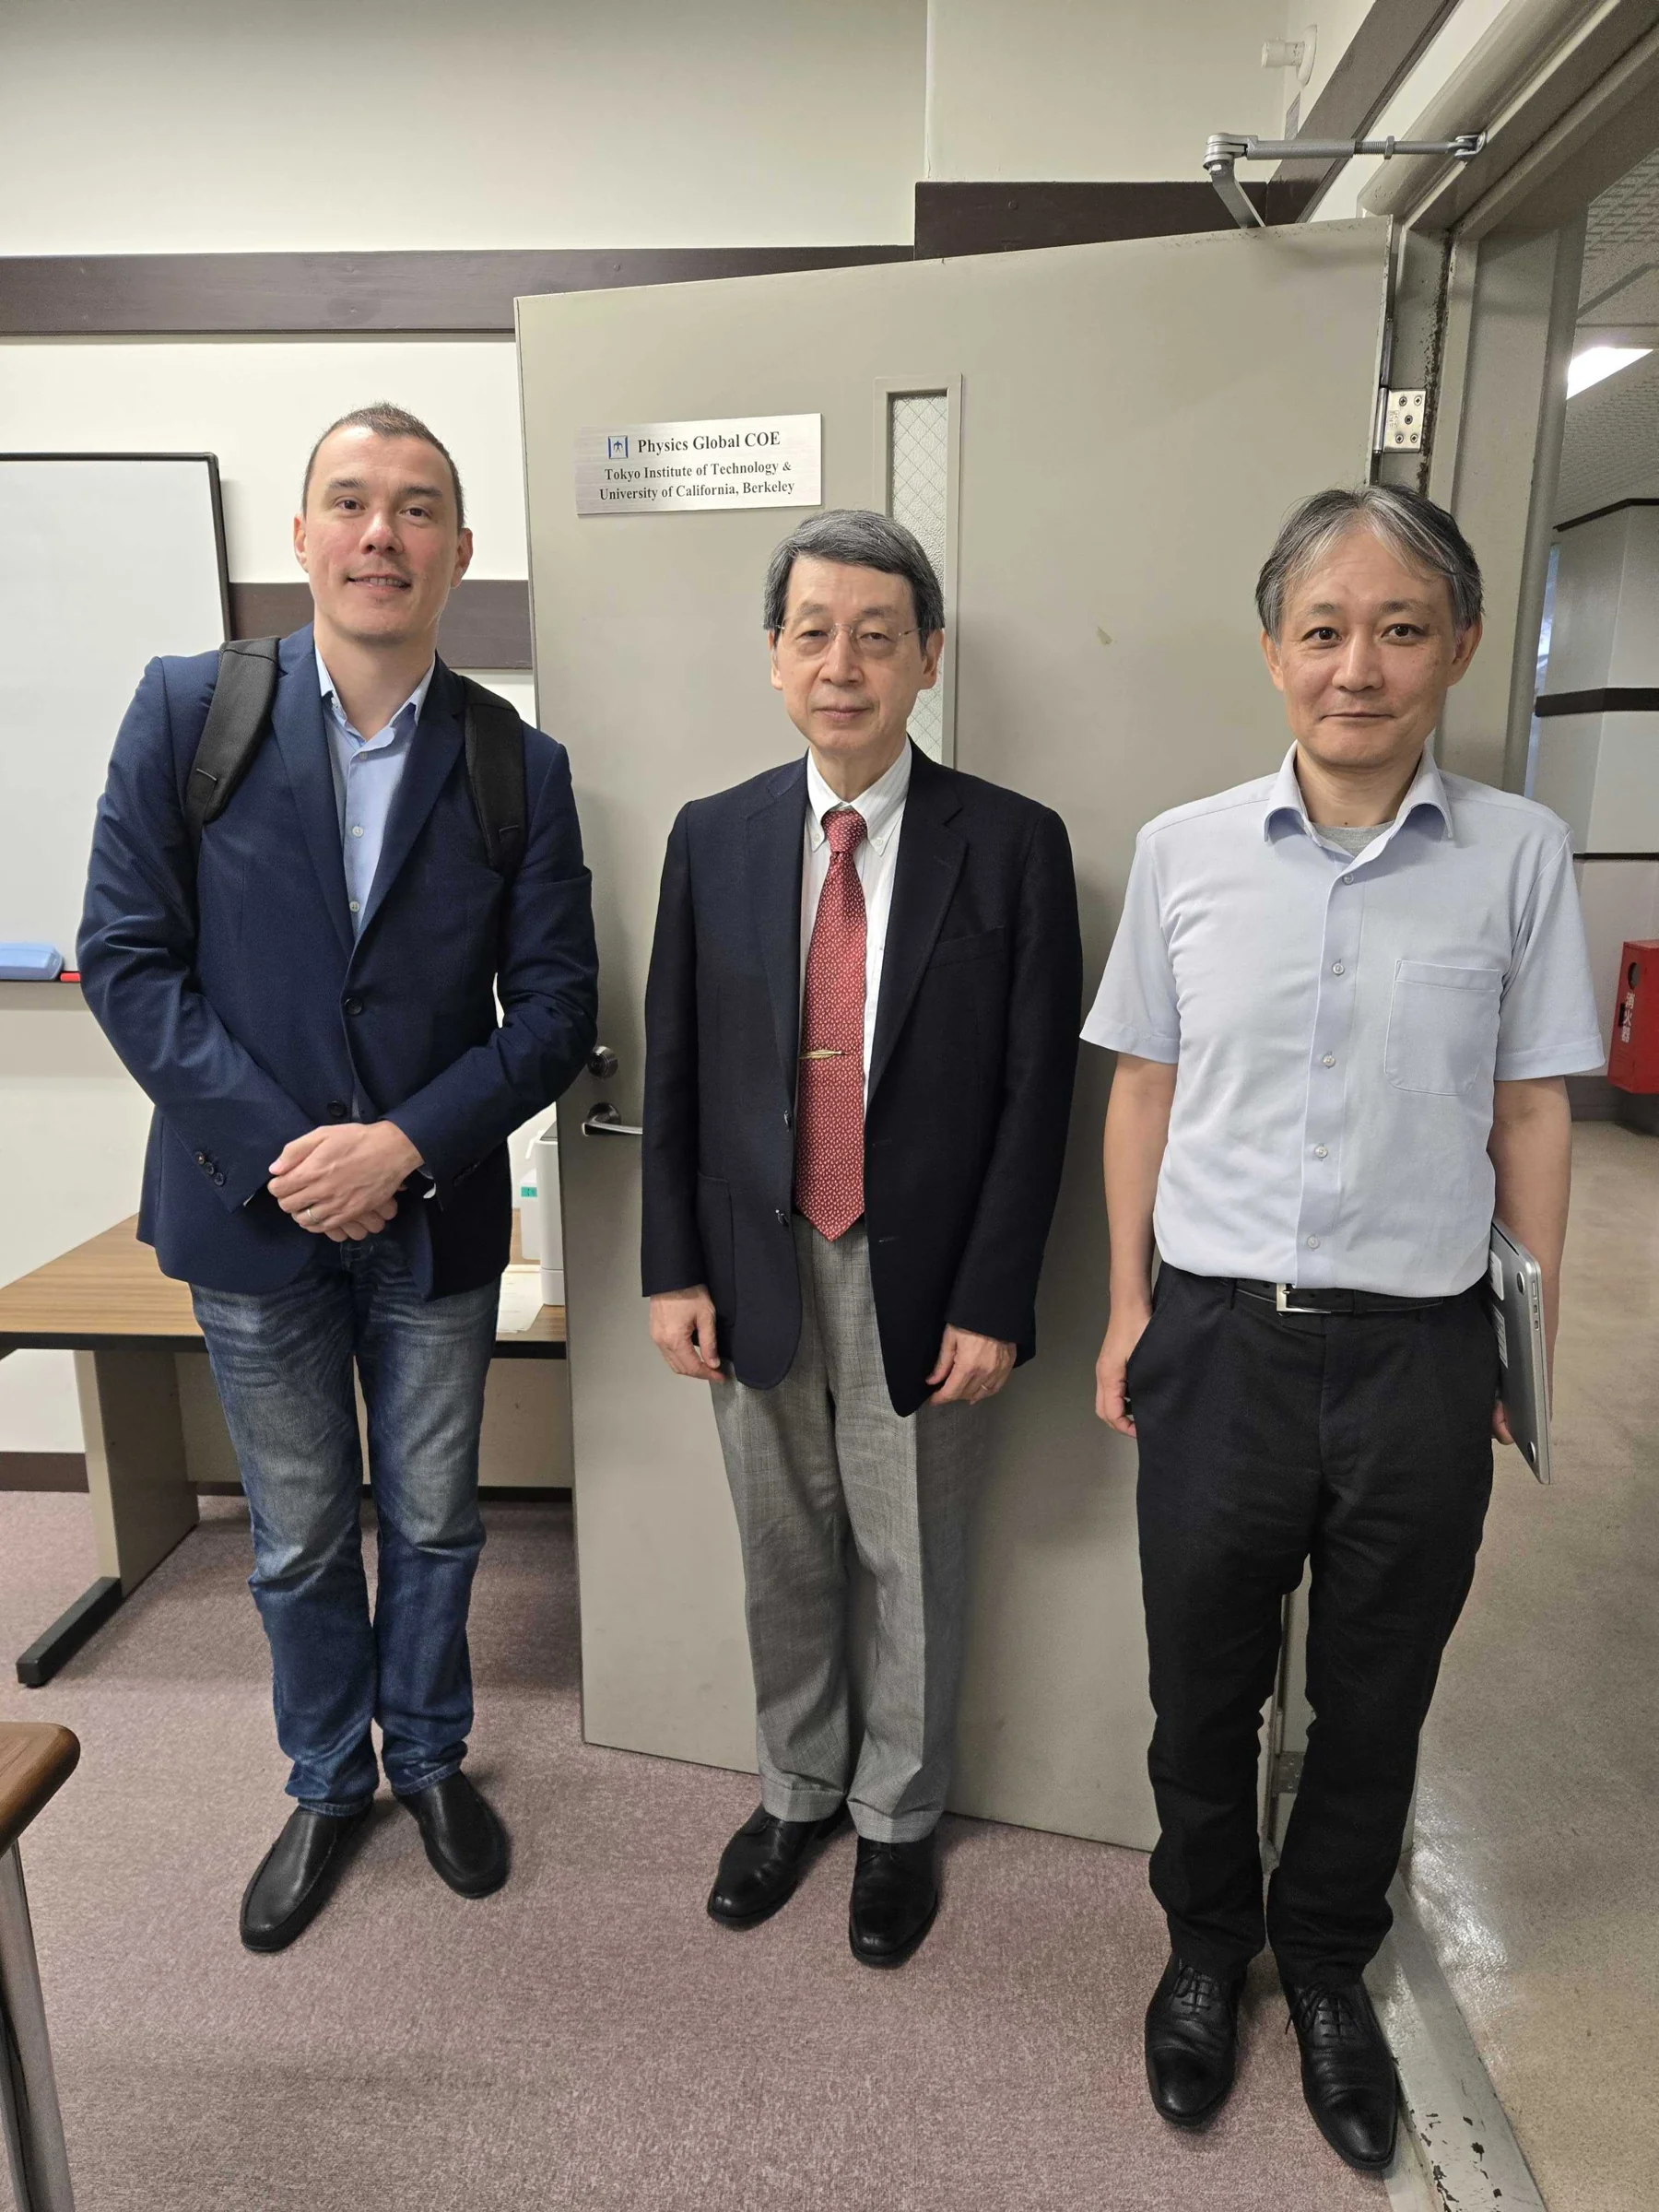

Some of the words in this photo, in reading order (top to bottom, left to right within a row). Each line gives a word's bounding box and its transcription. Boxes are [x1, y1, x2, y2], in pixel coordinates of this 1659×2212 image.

[638, 438, 688, 455] Physics
[693, 434, 740, 450] Global
[745, 431, 781, 447] COE
[605, 468, 641, 482] Tokyo
[644, 465, 693, 478] Institute
[696, 464, 708, 476] of
[711, 461, 779, 476] Technology
[782, 461, 792, 471] &
[599, 487, 658, 501] University
[662, 486, 674, 498] of
[677, 483, 739, 497] California,
[743, 480, 794, 495] Berkeley
[1621, 992, 1635, 1043] 消火器
